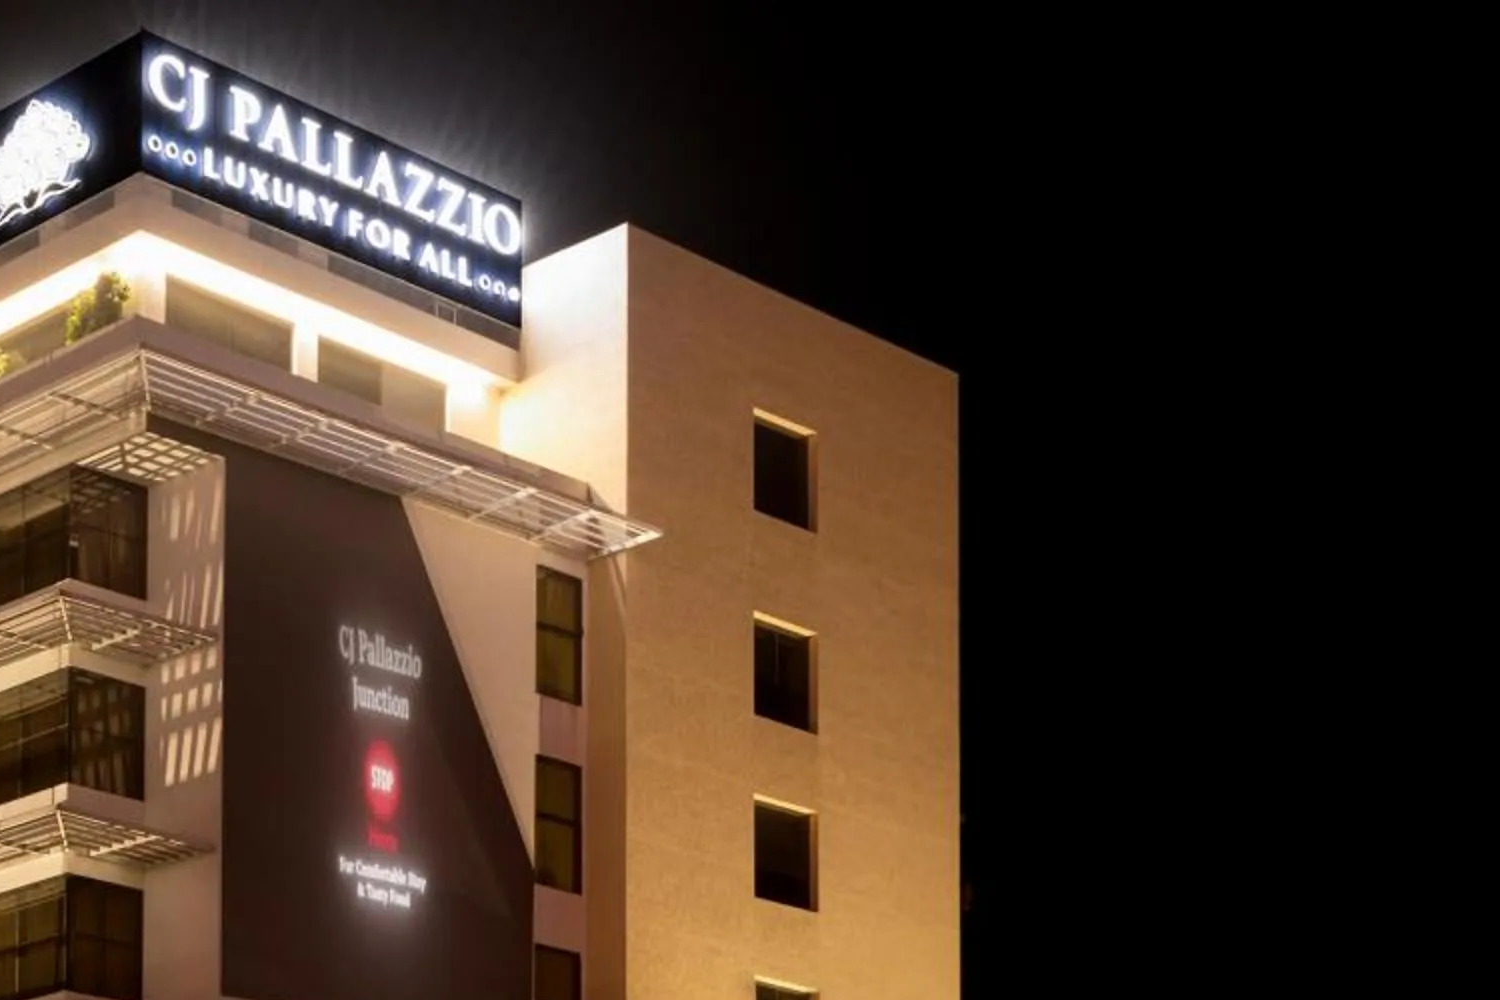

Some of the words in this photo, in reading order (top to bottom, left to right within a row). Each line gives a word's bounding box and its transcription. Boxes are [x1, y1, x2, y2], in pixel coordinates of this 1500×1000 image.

[148, 54, 210, 131] CJ
[229, 85, 521, 256] PALLAZZIO
[203, 146, 339, 228] LUXURY
[348, 207, 411, 261] FOR
[418, 242, 473, 288] ALL
[352, 676, 410, 721] Junction
[358, 628, 422, 679] Pallazzio
